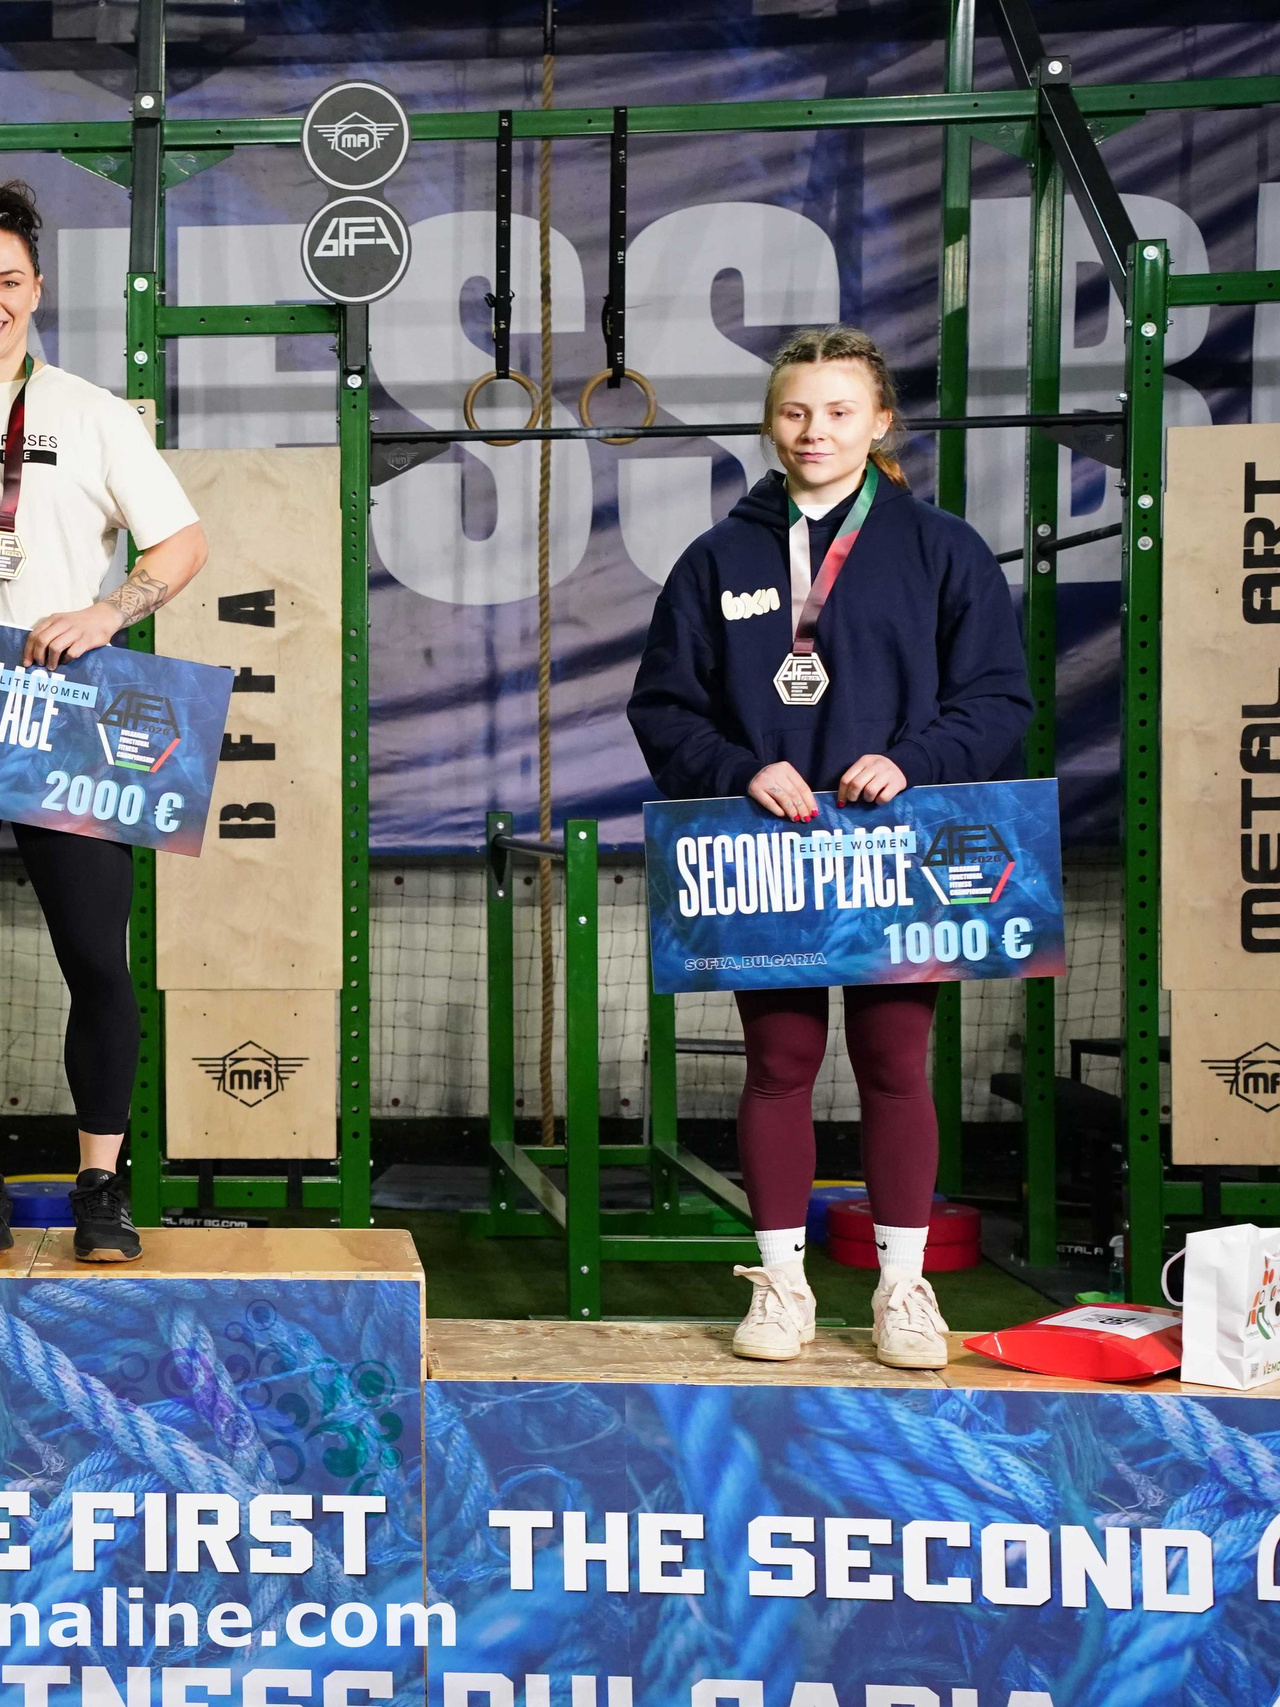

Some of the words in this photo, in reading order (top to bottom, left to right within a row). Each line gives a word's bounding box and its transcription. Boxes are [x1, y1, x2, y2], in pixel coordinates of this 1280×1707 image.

[341, 133, 370, 148] MA
[38, 682, 91, 701] WOMEN
[41, 770, 146, 826] 2000
[154, 792, 185, 833] €
[799, 842, 843, 853] ELITE
[851, 838, 909, 850] WOMEN
[970, 855, 1002, 864] 2026
[676, 831, 805, 918] SECOND
[811, 825, 914, 910] PLACE
[883, 918, 989, 965] 1000
[1002, 917, 1033, 960] €
[685, 957, 741, 971] SOFIA,
[743, 953, 828, 969] BULGARIA
[229, 1069, 272, 1090] MA
[72, 1492, 387, 1576] FIRST
[488, 1510, 706, 1595] THE
[748, 1515, 1215, 1613] SECOND
